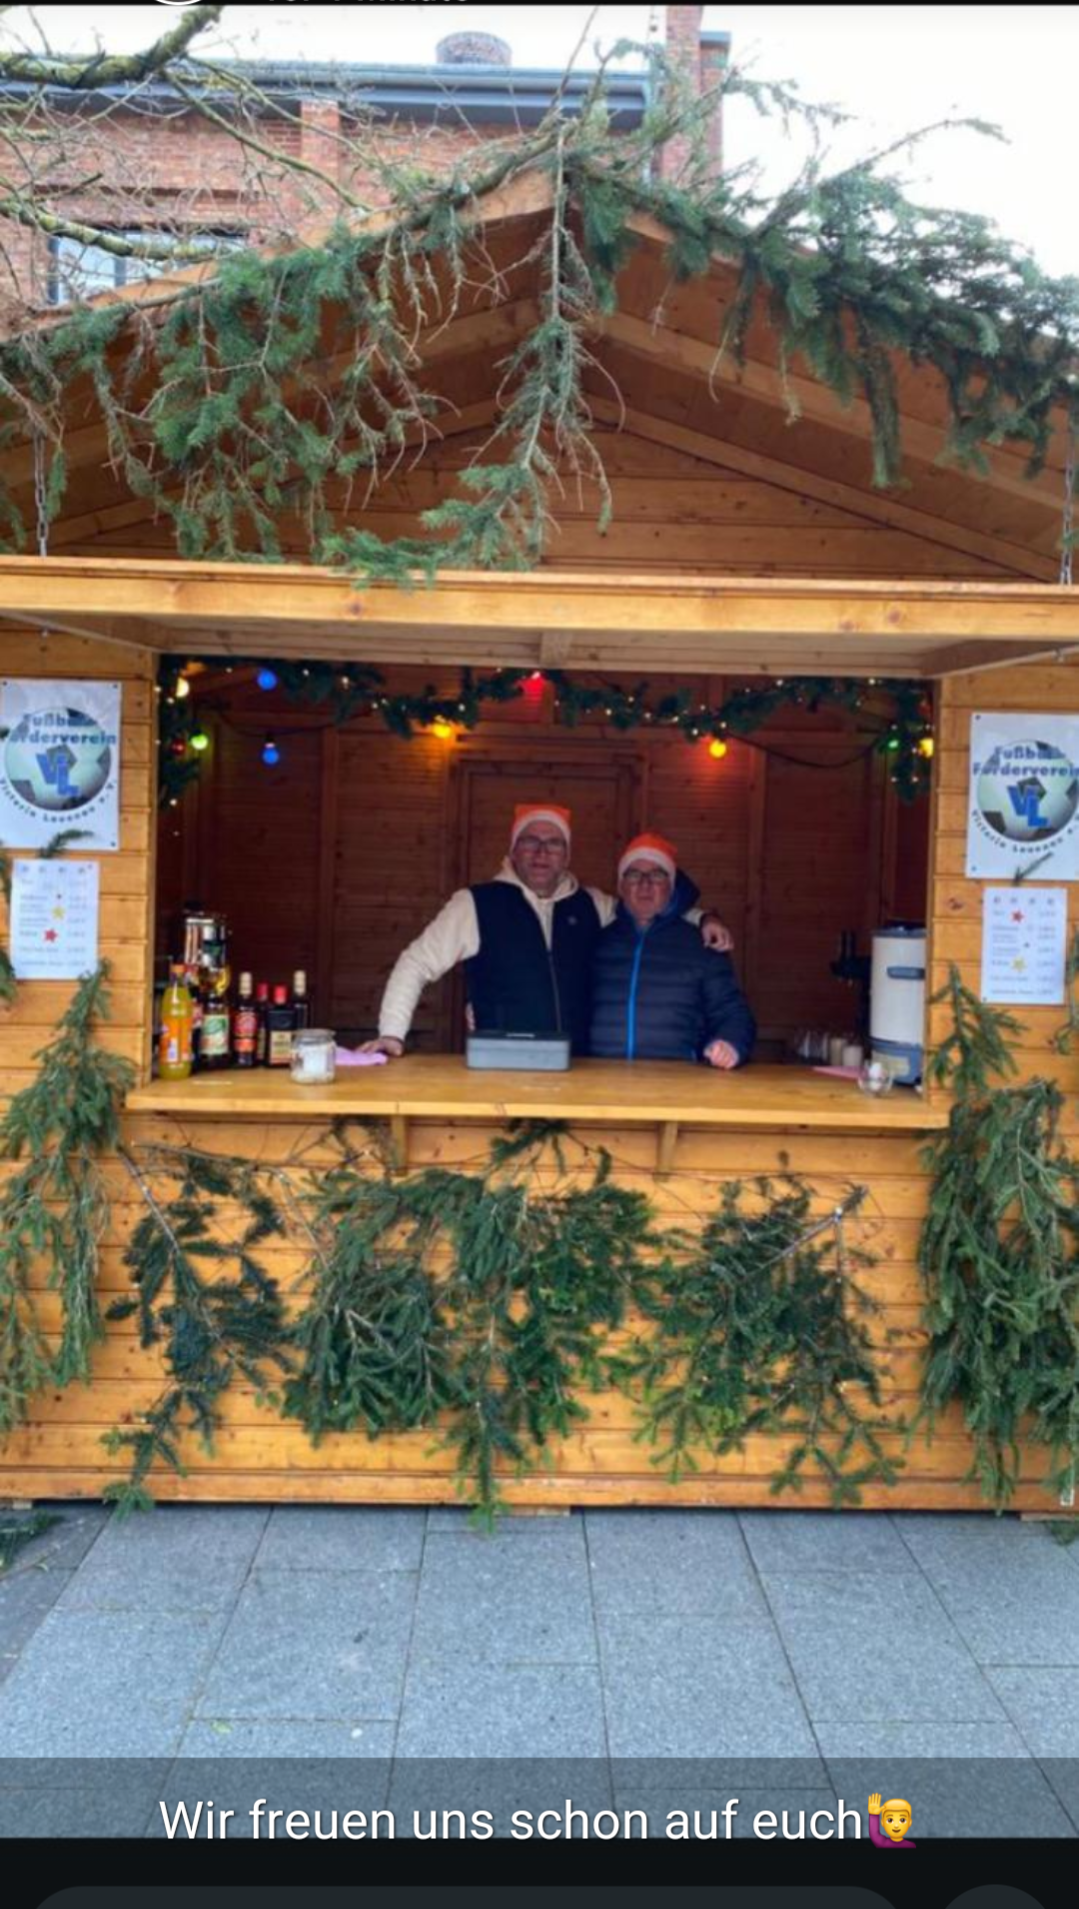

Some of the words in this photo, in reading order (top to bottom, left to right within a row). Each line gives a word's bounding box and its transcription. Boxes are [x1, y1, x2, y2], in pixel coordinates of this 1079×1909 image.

[23, 712, 97, 727] Fußb
[1, 729, 117, 743] örderverein
[994, 746, 1067, 760] Fußb
